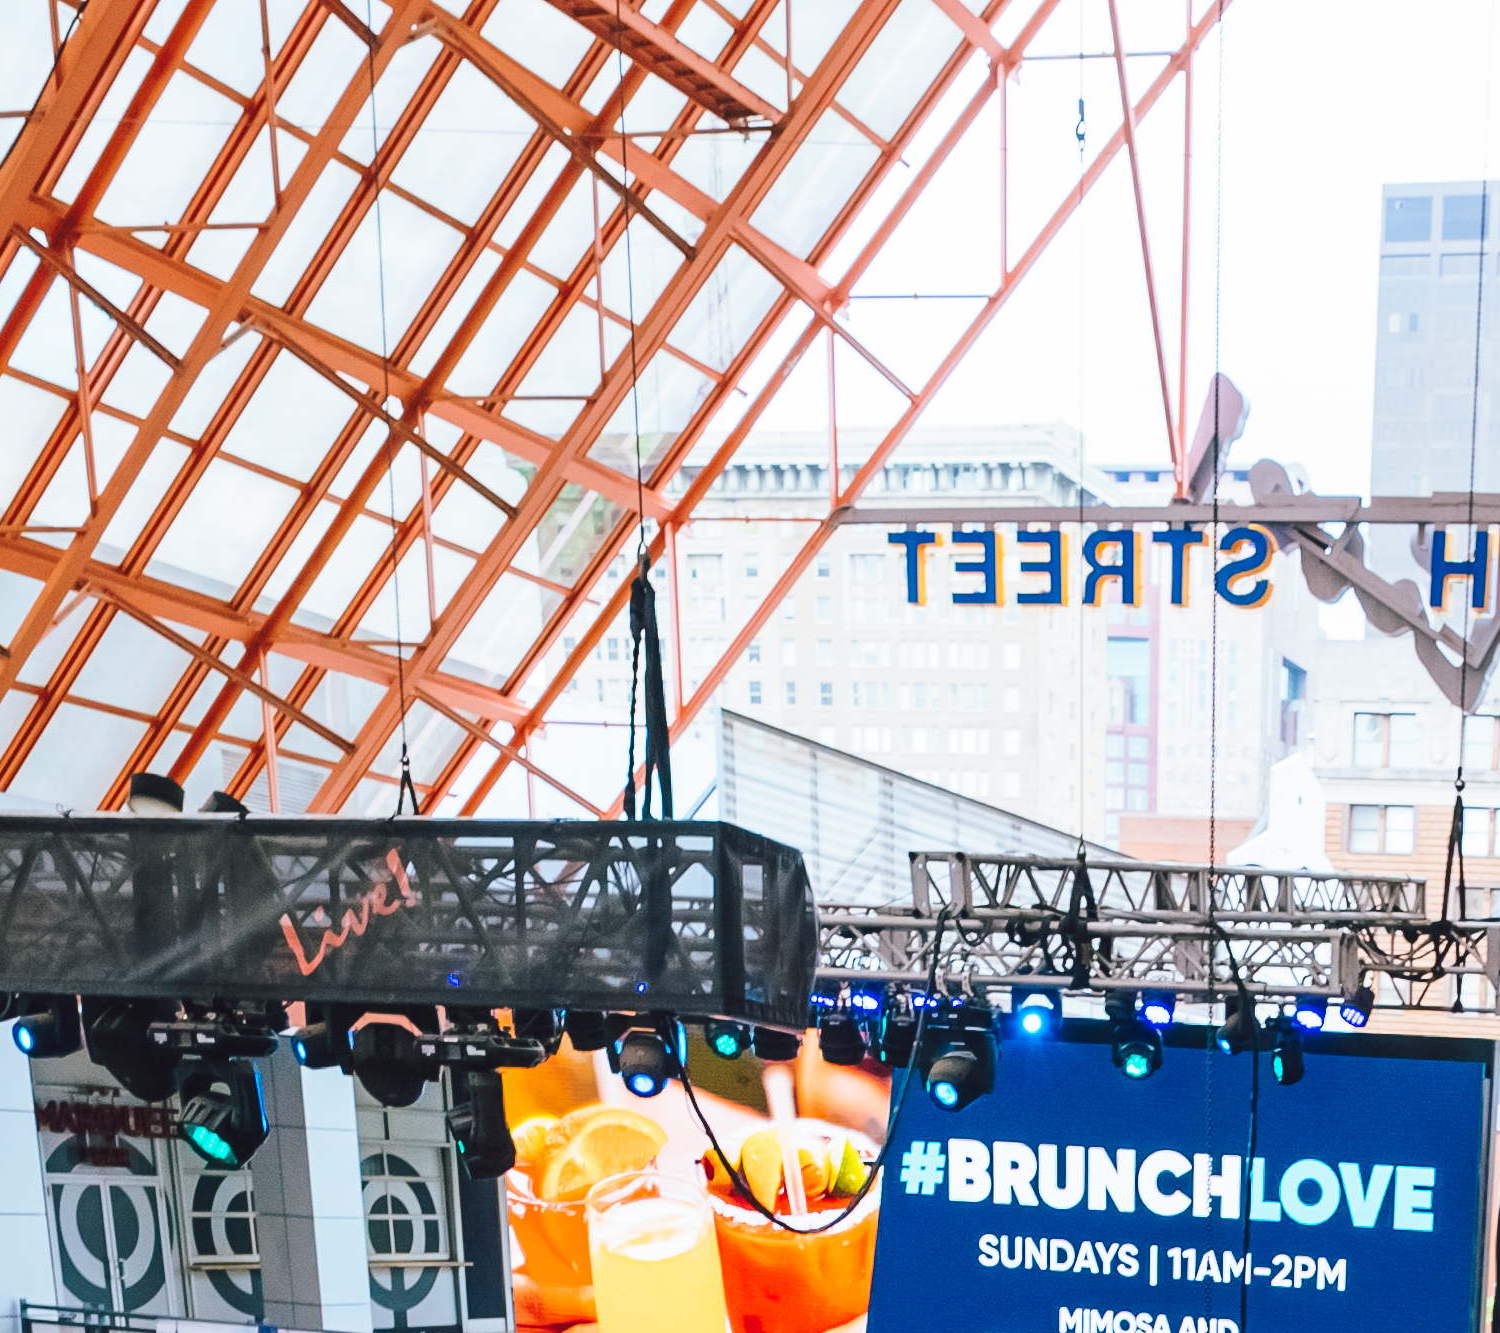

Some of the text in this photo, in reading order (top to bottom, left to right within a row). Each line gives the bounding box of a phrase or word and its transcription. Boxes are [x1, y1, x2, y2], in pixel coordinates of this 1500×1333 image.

[279, 846, 422, 976] Live!
[901, 1139, 1436, 1232] #BRUNCHLOVE
[978, 1233, 1139, 1278] SUNDAYS
[1167, 1246, 1347, 1292] 11AM-2PM
